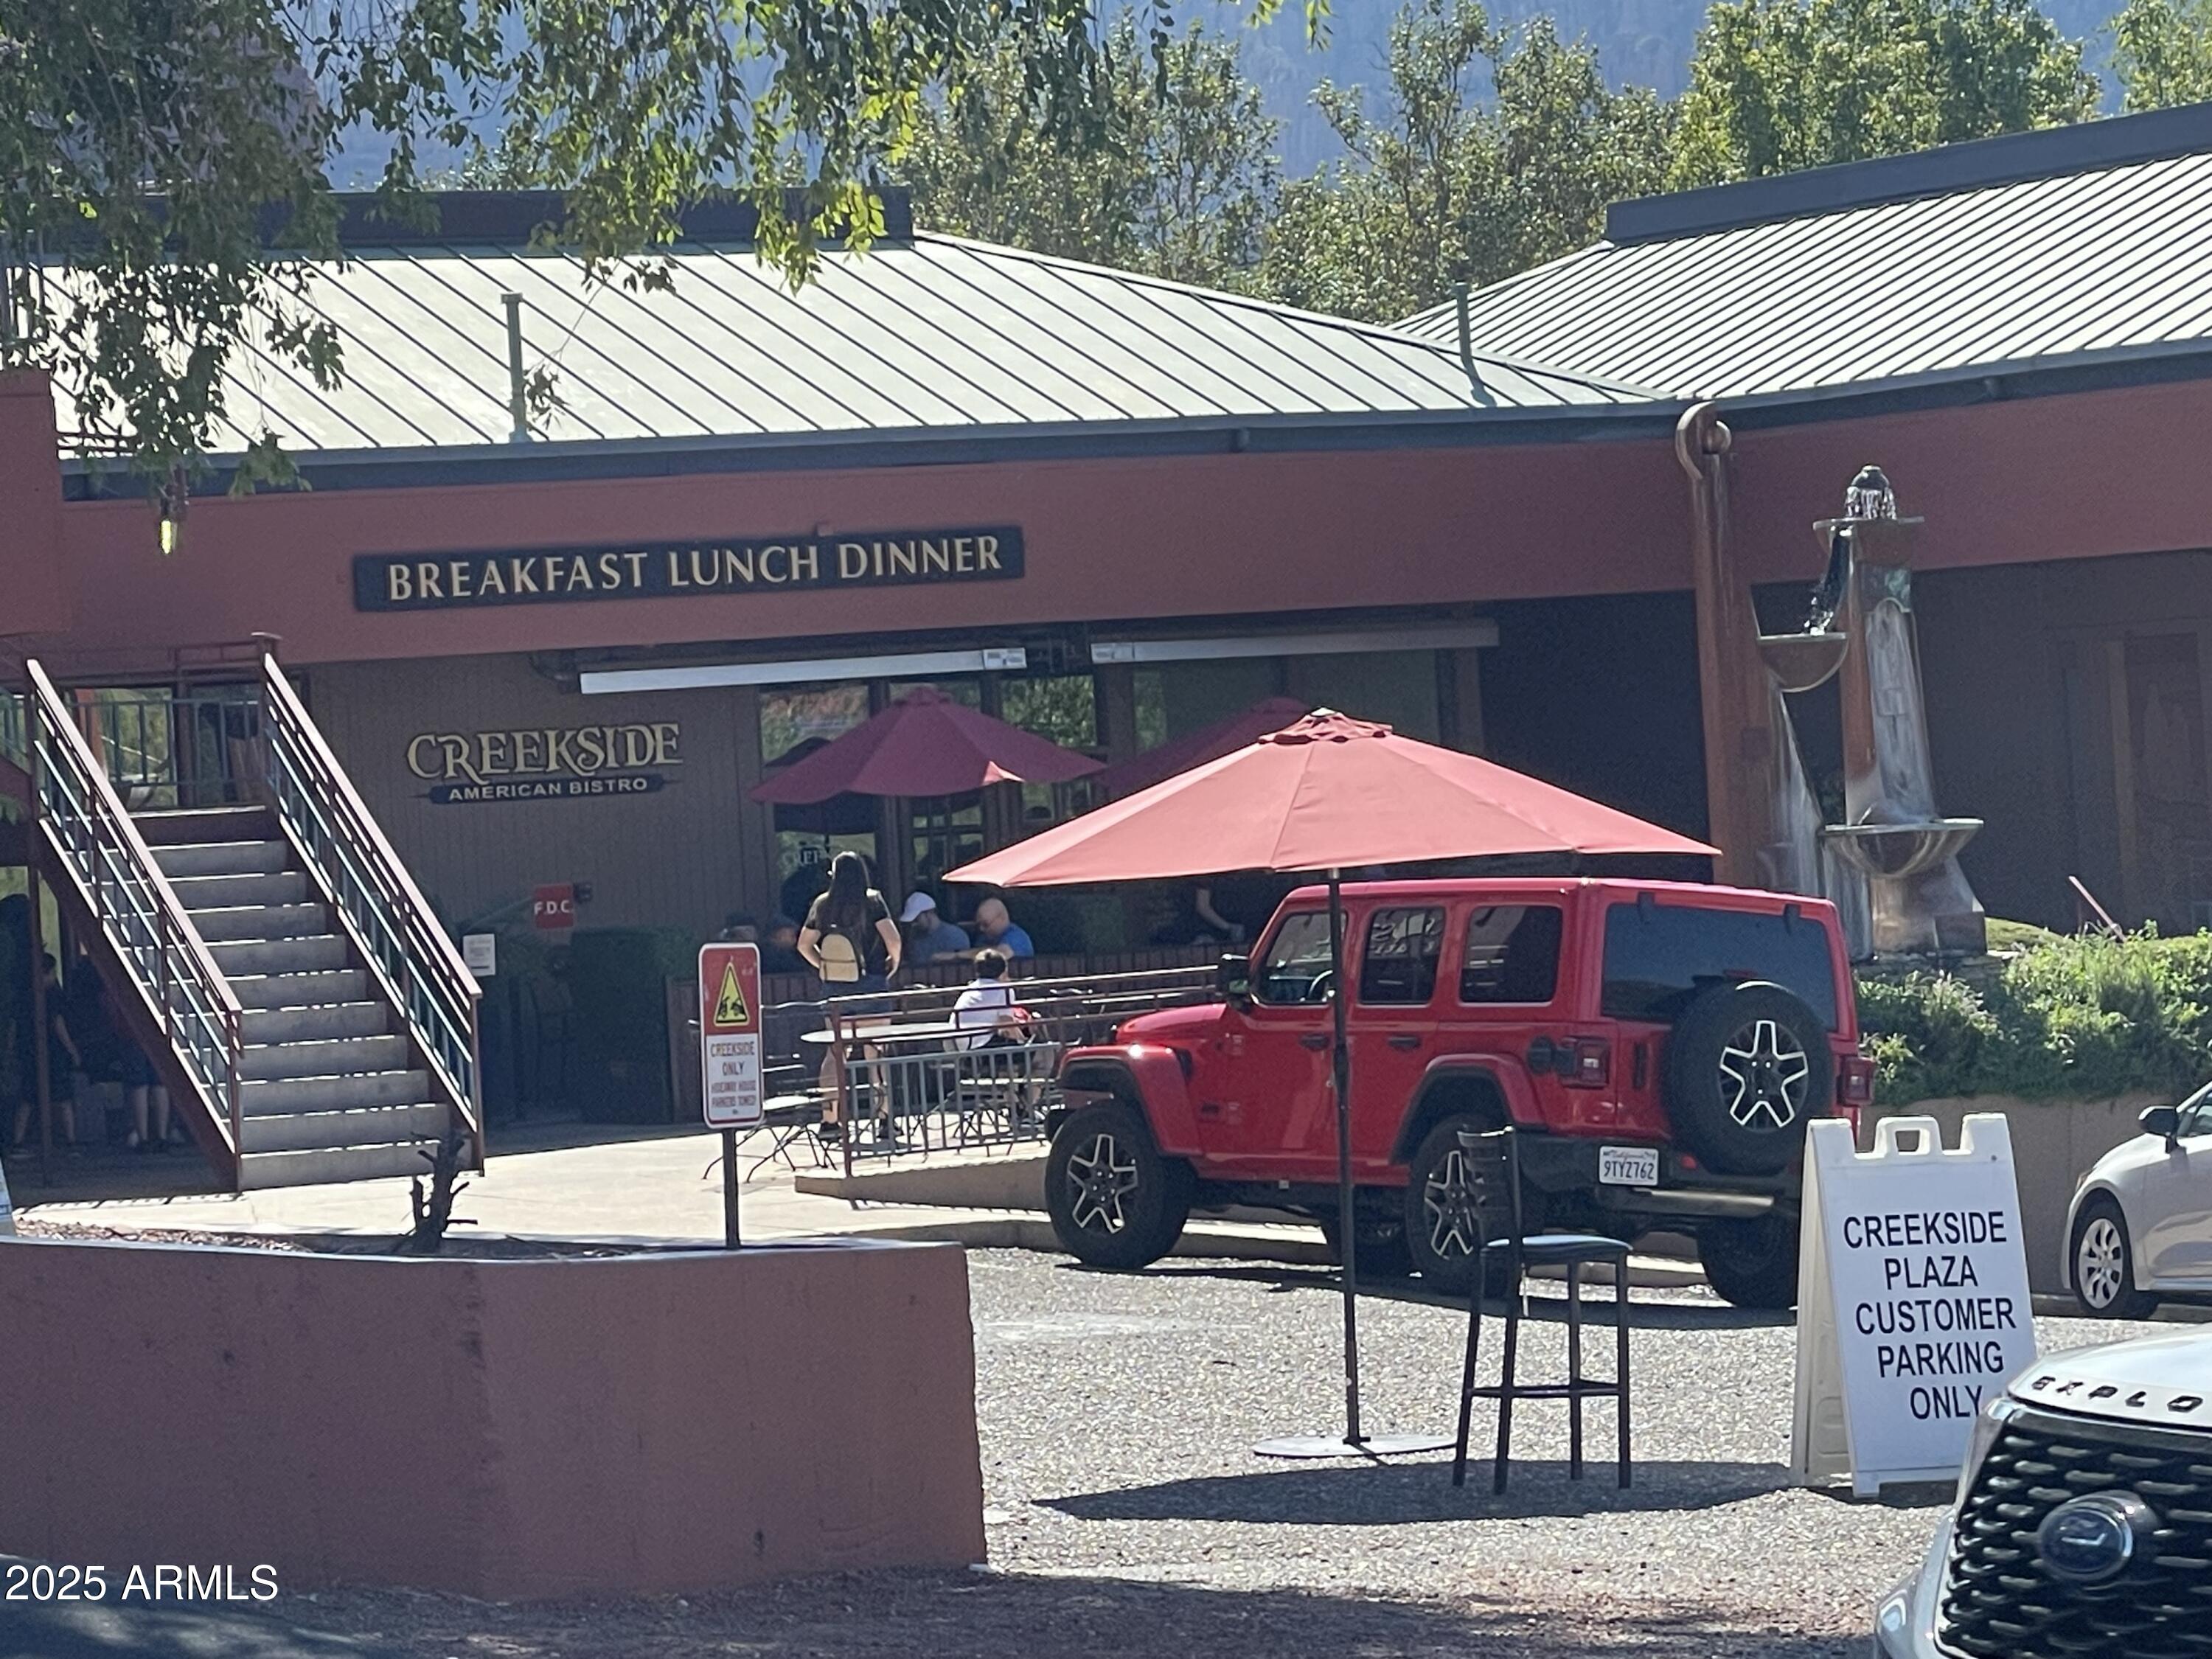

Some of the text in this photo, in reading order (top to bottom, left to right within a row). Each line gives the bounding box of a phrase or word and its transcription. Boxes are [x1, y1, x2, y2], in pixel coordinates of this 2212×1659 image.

[388, 535, 1003, 600] BREAKFAST LUNCH DINNER
[406, 723, 684, 785] CREEKSIDE
[448, 776, 648, 801] AMERICAN BISTRO
[710, 1041, 755, 1057] CREEKSIDE
[722, 1061, 745, 1076] ONLY
[1604, 1161, 1655, 1180] 9TYZ762
[1843, 1211, 2007, 1249] CREEKSIDE
[1884, 1255, 1978, 1290] PLAZA
[1855, 1297, 2017, 1335] CUSTOMER
[1877, 1340, 2004, 1378] PARKING
[1910, 1385, 1983, 1419] ONLY
